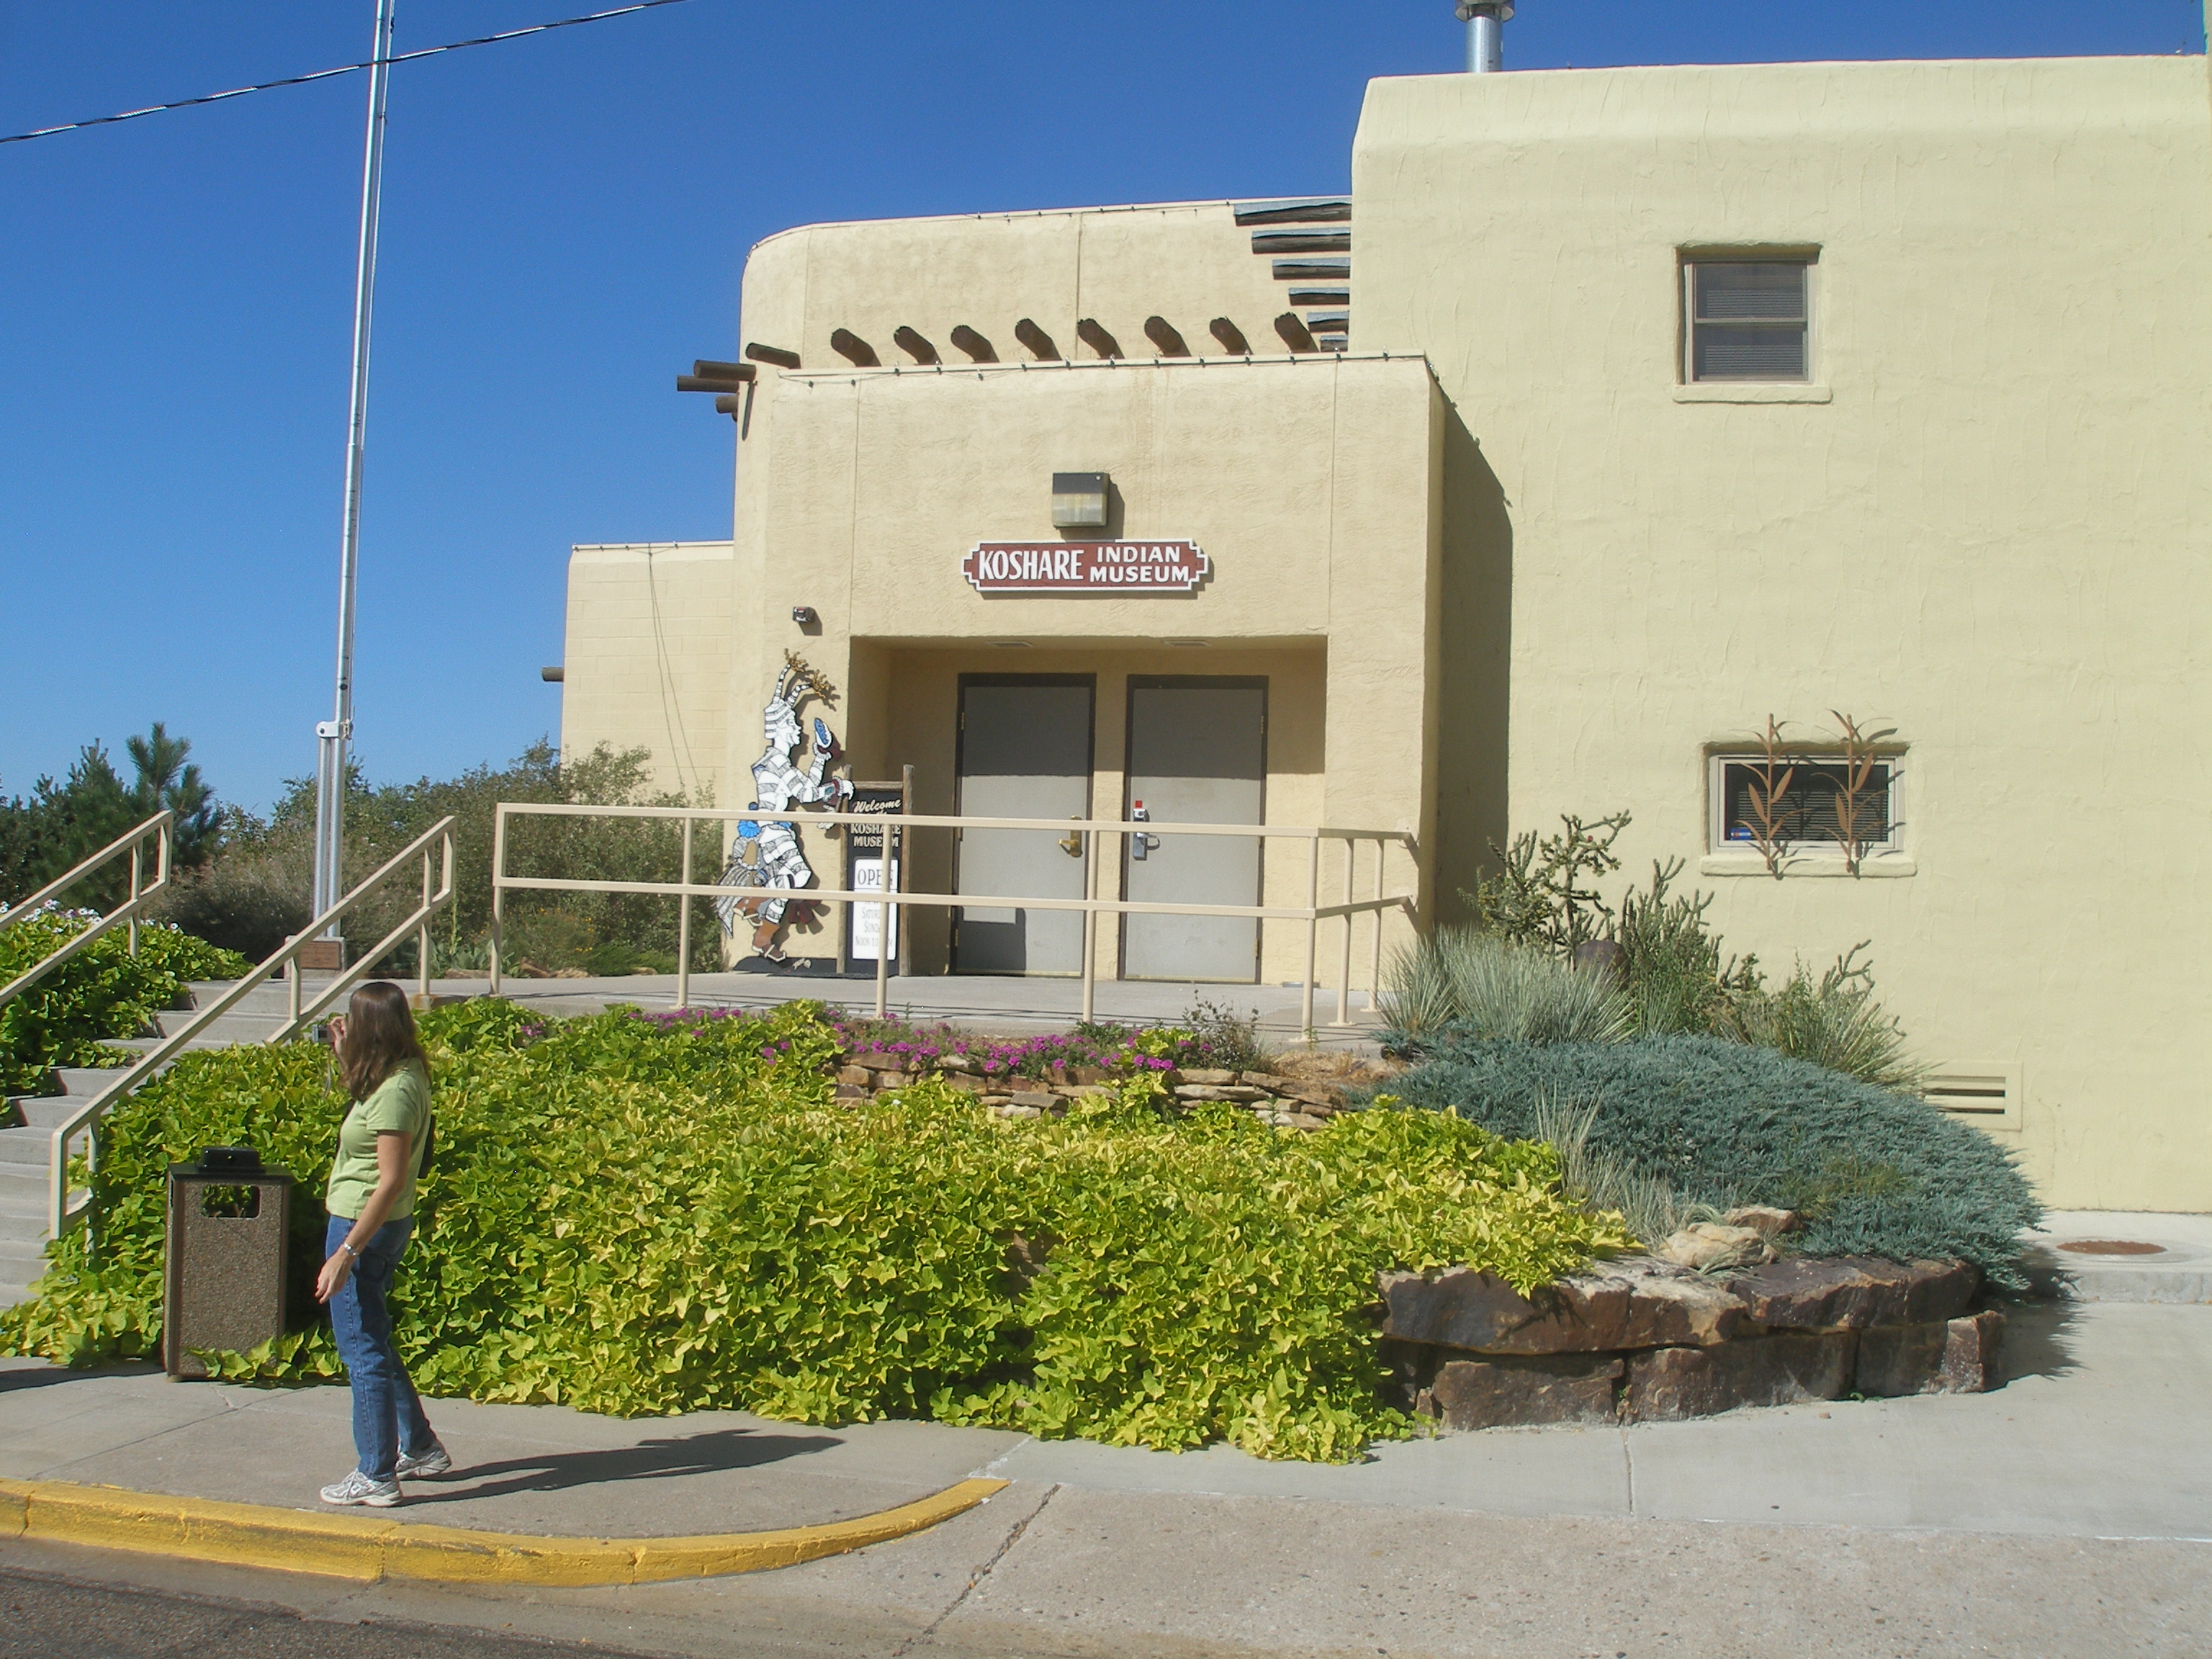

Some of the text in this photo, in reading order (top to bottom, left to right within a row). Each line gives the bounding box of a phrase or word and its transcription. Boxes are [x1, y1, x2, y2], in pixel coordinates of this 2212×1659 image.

[1097, 546, 1180, 562] INDIAN
[979, 549, 1084, 580] KOSHARE
[1089, 566, 1189, 583] MUSEUM
[853, 799, 901, 812] Welcome
[850, 823, 901, 834] KOSHAE
[853, 836, 899, 848] MUSEM
